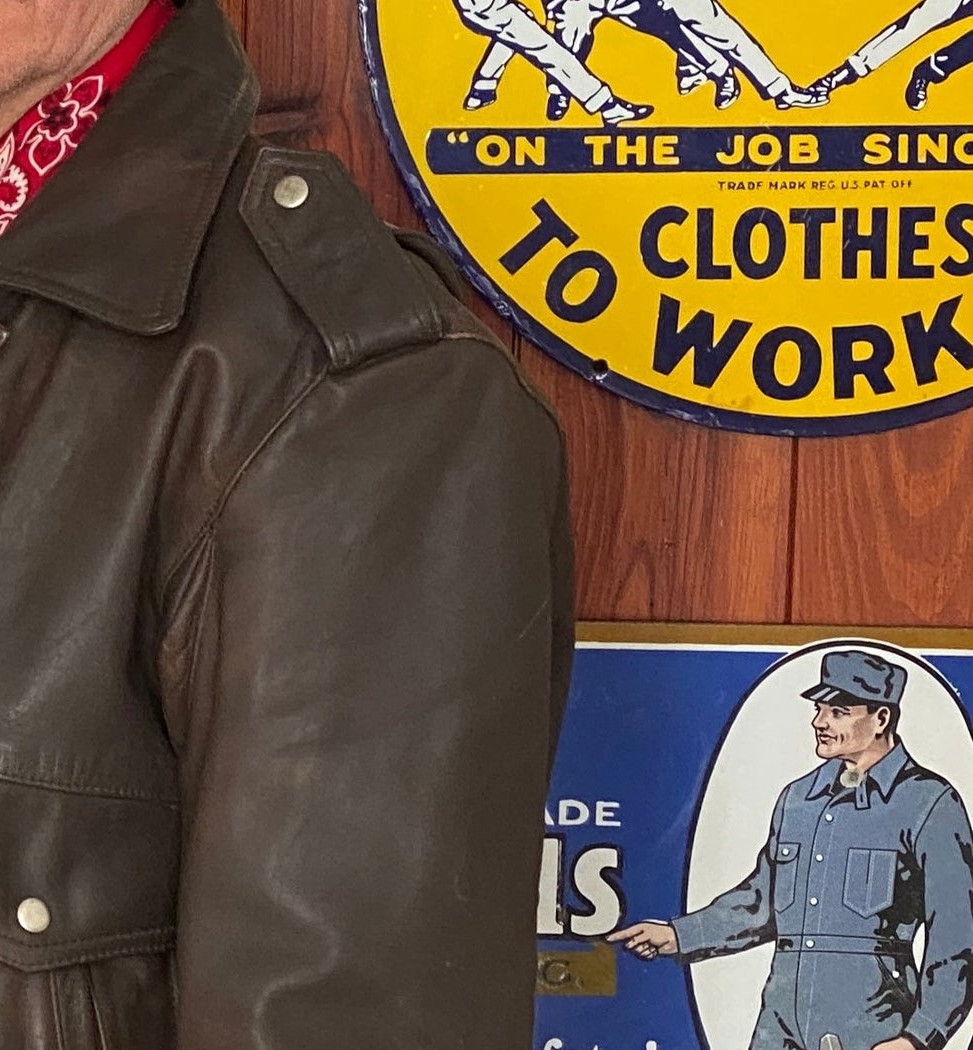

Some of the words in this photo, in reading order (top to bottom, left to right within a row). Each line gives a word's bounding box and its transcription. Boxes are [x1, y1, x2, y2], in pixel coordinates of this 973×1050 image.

[584, 134, 680, 166] THE
[715, 133, 820, 166] JOB
[769, 181, 806, 191] MARK
[864, 180, 885, 190] PAT
[639, 203, 973, 281] CLOTHES
[498, 198, 619, 325] TO
[652, 293, 973, 401] WORK
